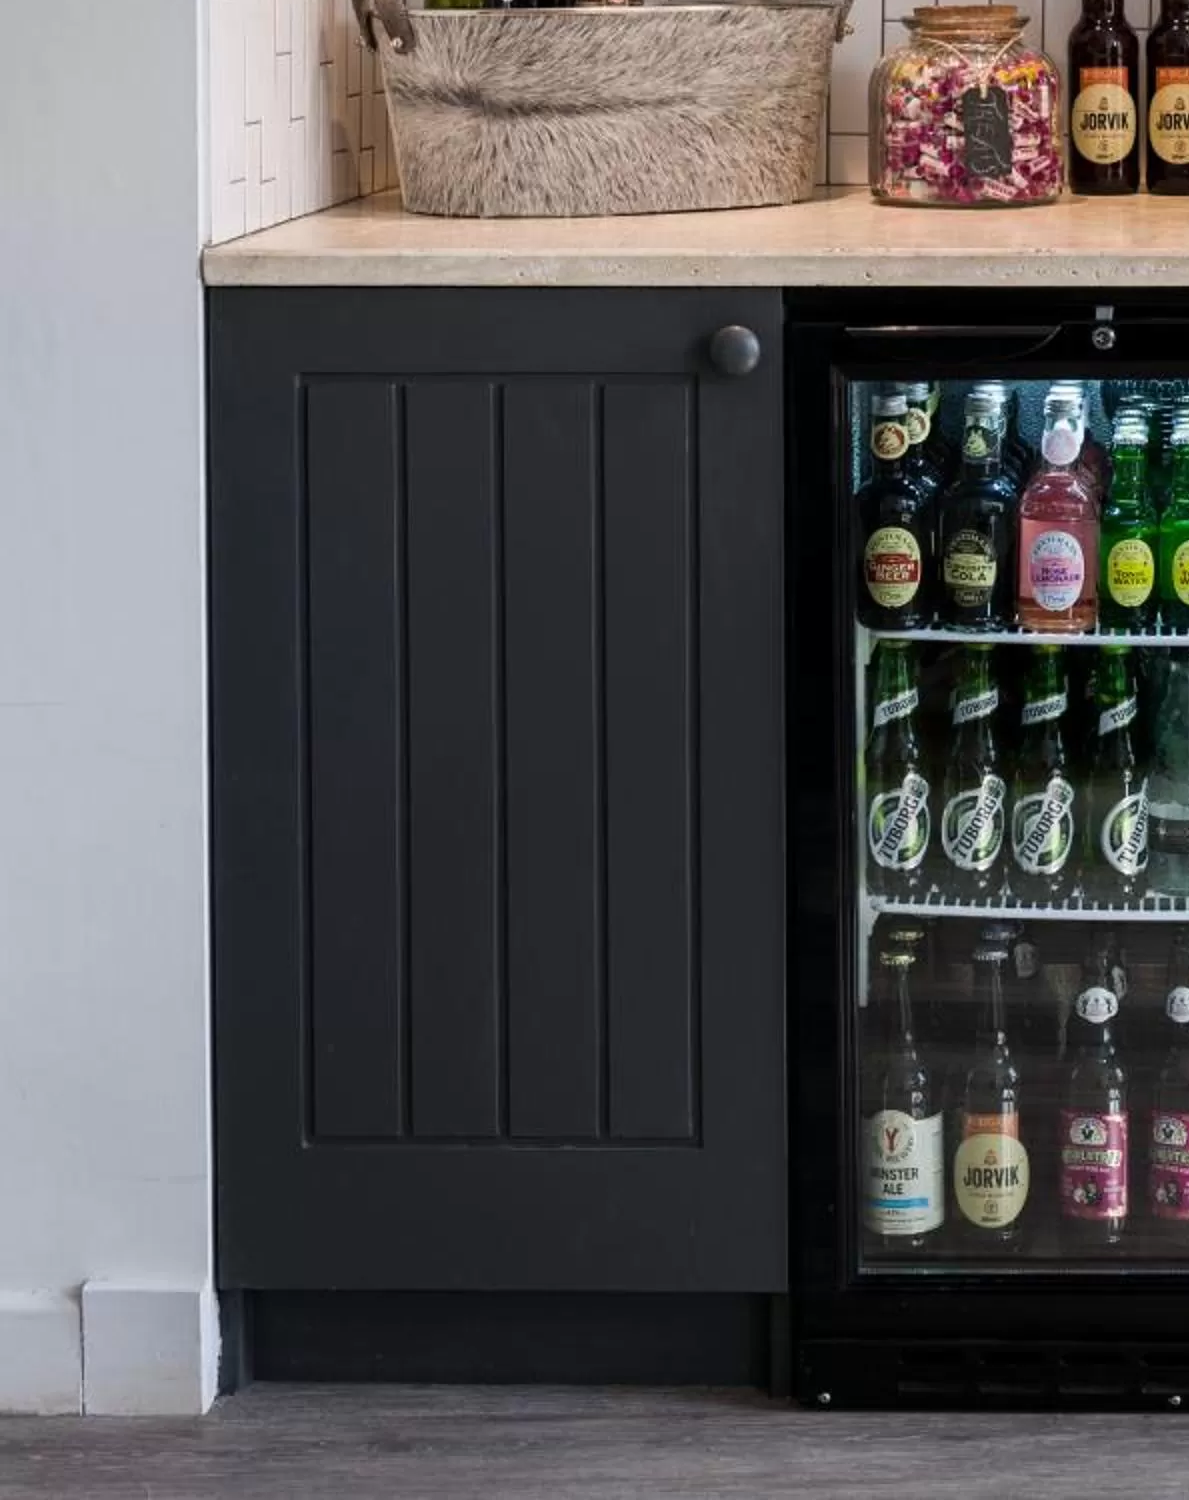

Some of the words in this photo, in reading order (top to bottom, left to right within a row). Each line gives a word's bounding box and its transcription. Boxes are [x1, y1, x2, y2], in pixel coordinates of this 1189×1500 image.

[1080, 112, 1129, 131] JORVIK
[877, 794, 919, 860] TUBORG
[951, 796, 997, 859] TUBORG
[1020, 799, 1063, 862] TUBORG
[883, 1183, 905, 1195] ALE
[963, 1164, 1021, 1189] JORVIK
